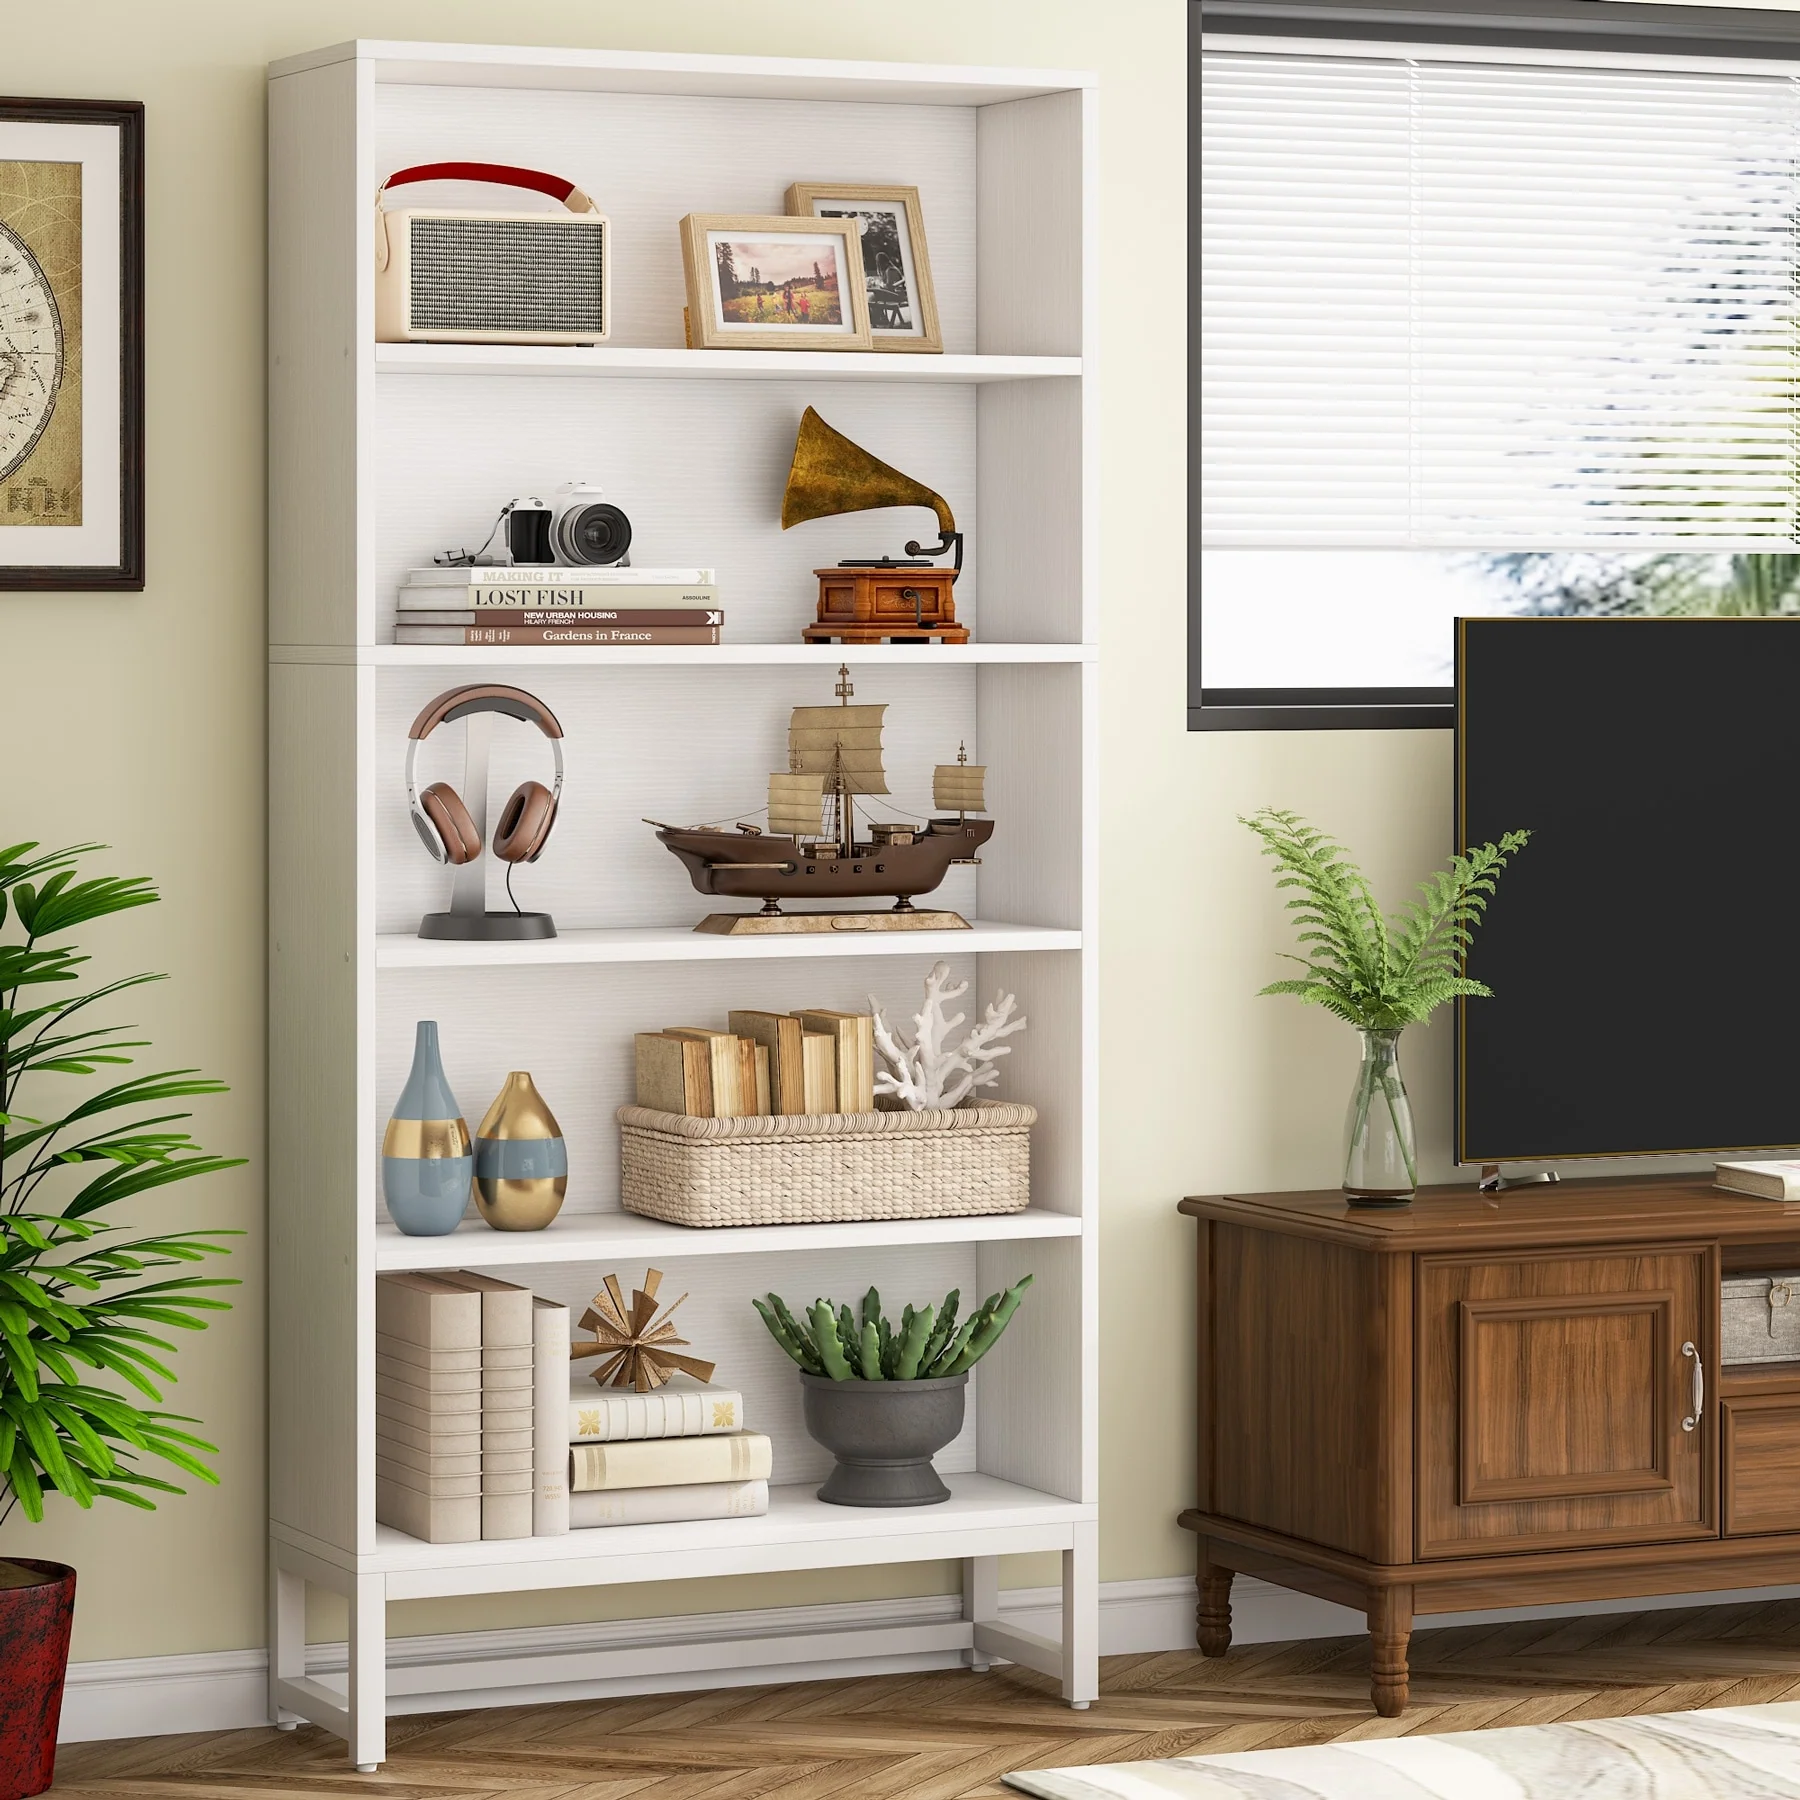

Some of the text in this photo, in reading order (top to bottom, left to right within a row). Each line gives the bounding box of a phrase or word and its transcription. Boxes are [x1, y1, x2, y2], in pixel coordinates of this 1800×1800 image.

[483, 572, 544, 581] MAKING
[548, 572, 563, 581] IT
[475, 589, 584, 605] LOST FISH
[542, 630, 652, 641] Gardens in France
